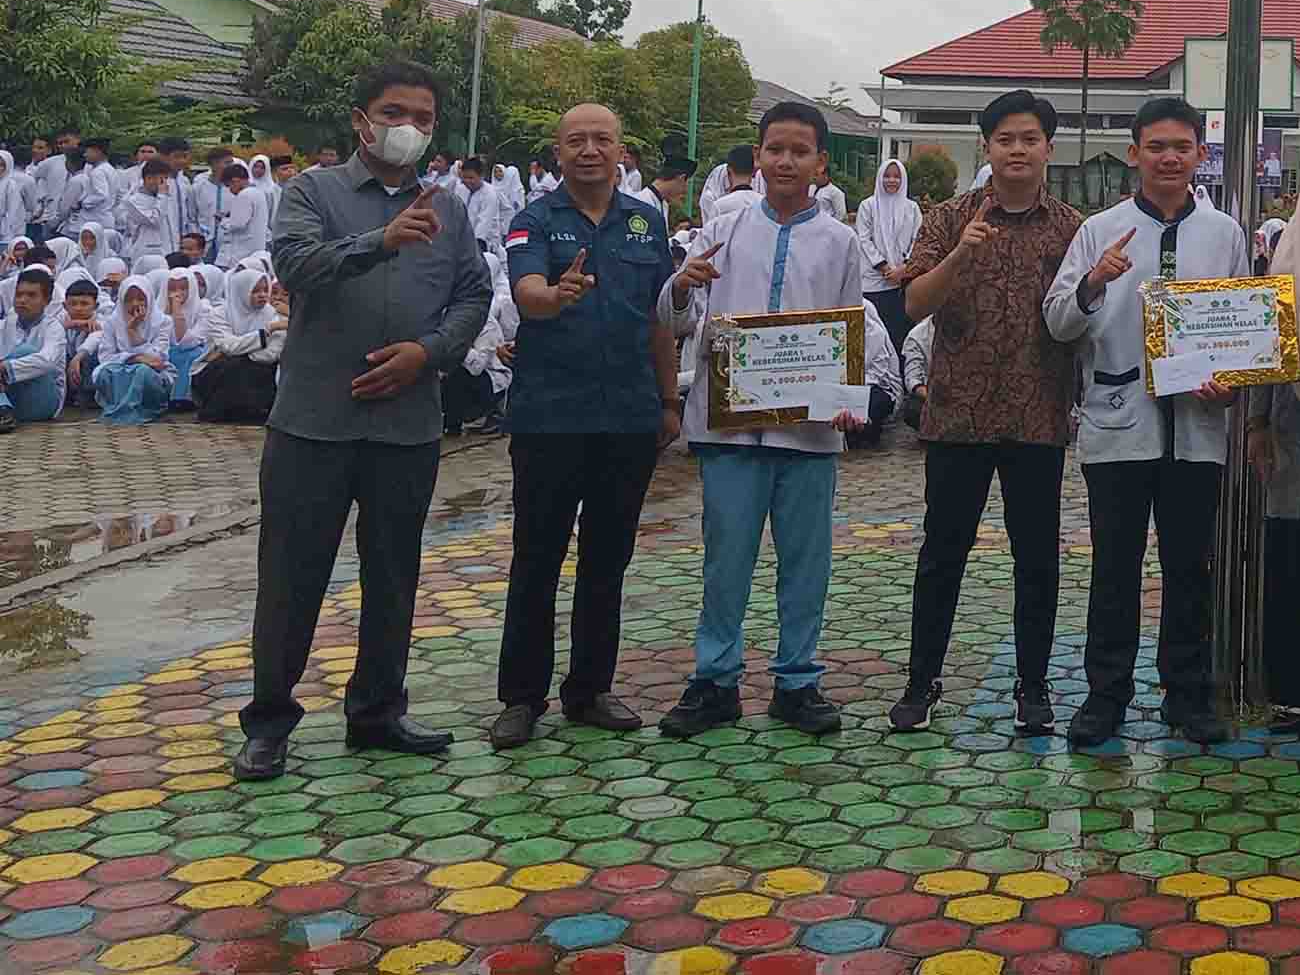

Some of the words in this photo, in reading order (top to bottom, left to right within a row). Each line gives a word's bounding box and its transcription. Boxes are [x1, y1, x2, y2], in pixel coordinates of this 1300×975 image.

[626, 233, 654, 243] PTSP
[774, 350, 799, 358] JUARA
[801, 354, 826, 363] KELAS
